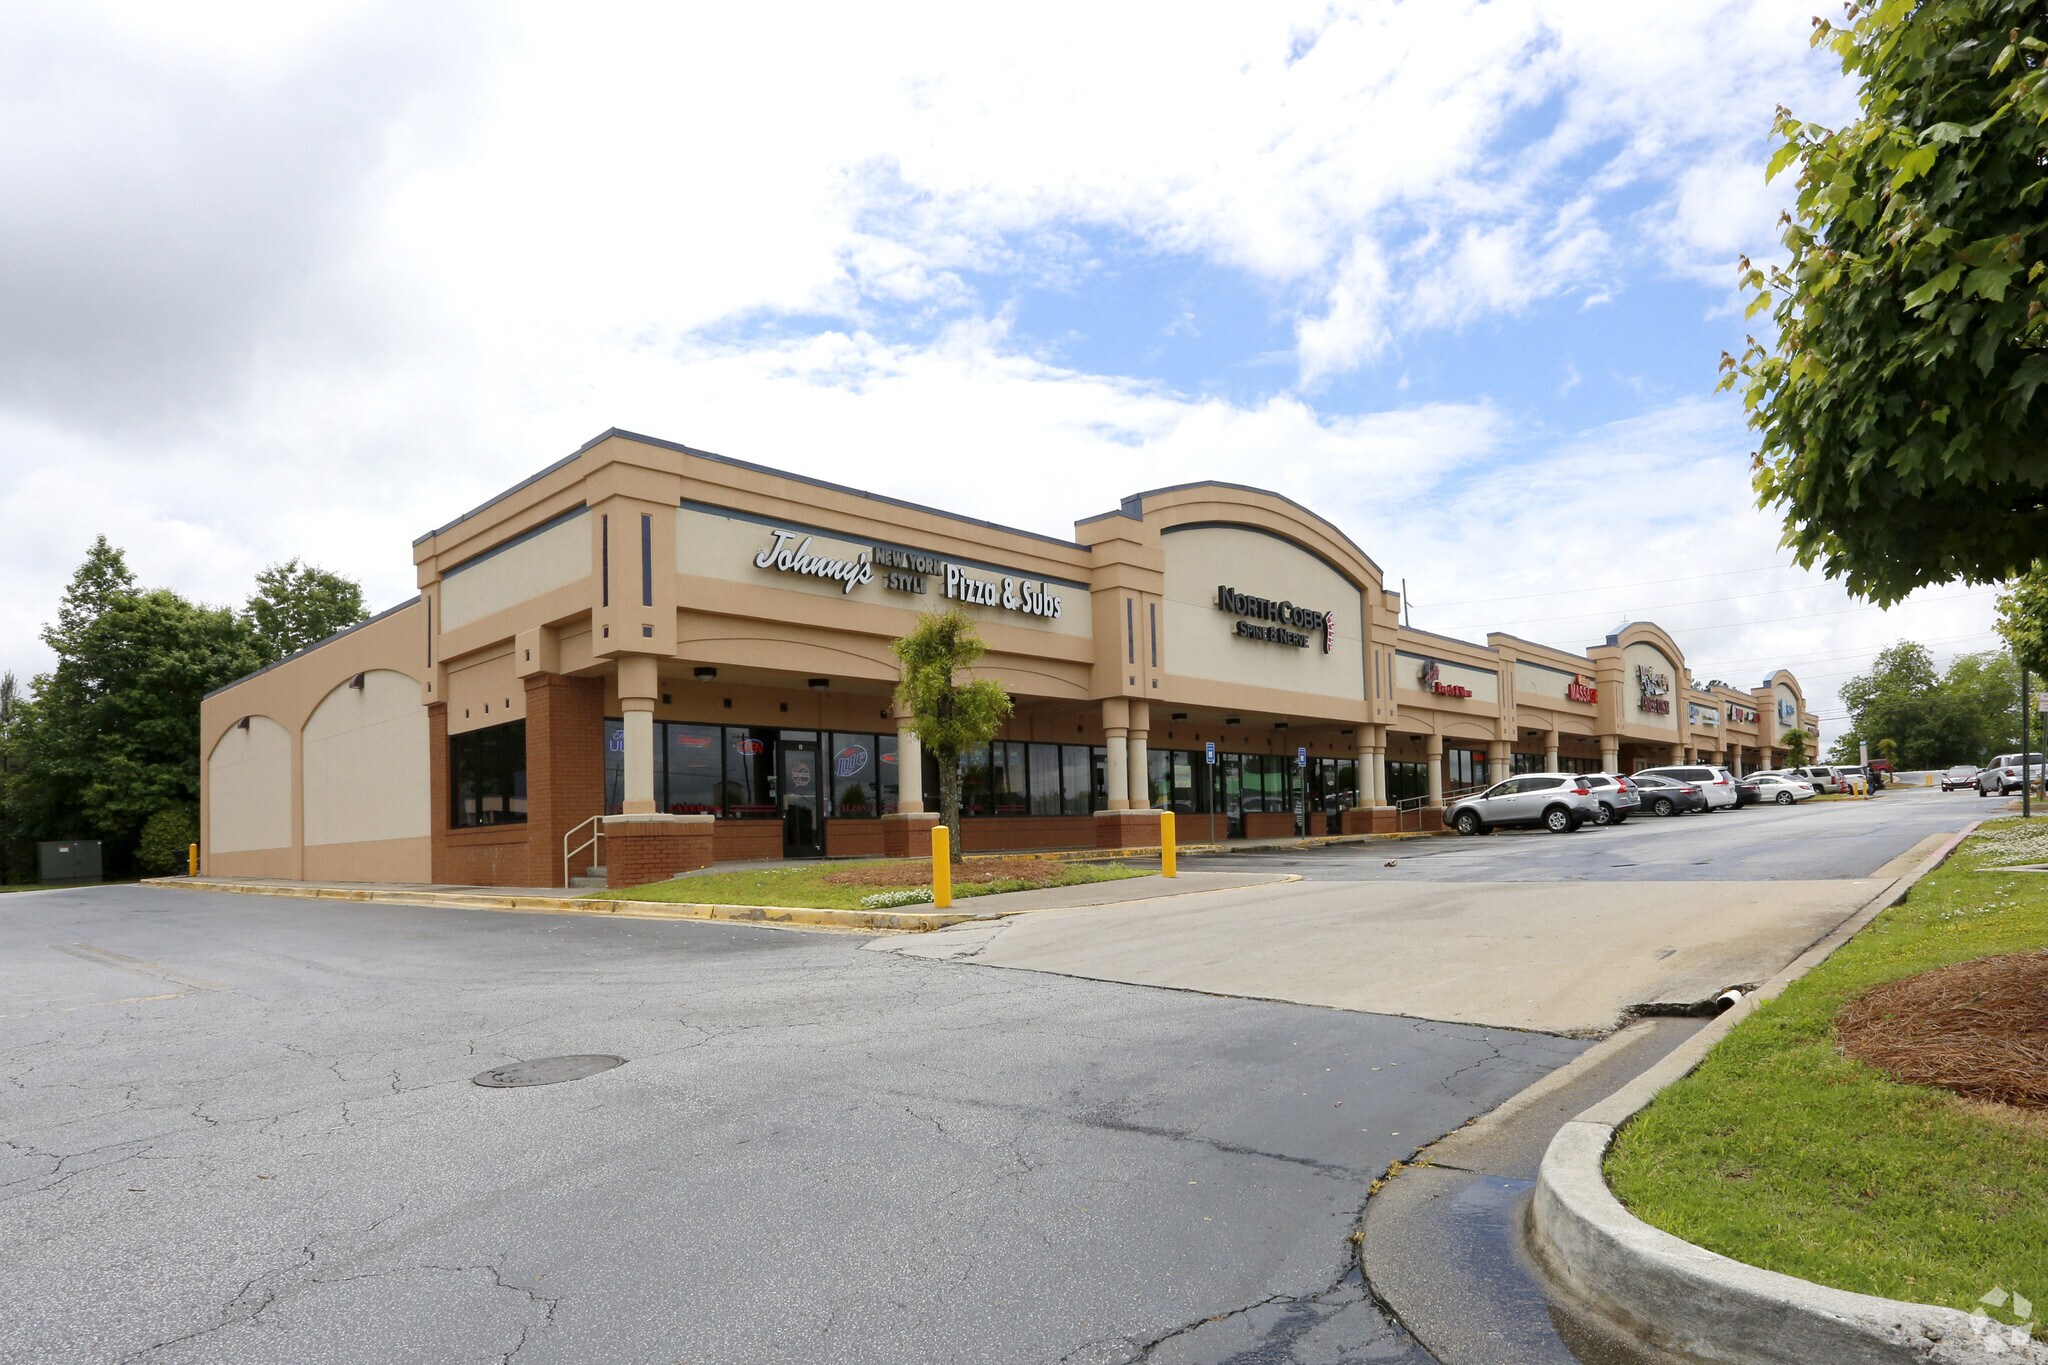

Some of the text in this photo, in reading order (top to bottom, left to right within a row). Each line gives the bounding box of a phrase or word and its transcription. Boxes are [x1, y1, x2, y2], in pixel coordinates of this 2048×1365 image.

[756, 530, 875, 594] Johnny's
[873, 547, 943, 577] NEW YORK
[887, 573, 928, 595] STYLE
[944, 564, 1063, 619] Pizza & Subs
[1218, 585, 1324, 631] NORTH COBB
[1236, 620, 1310, 648] SPINE & NERVE
[736, 740, 765, 754] OPEN
